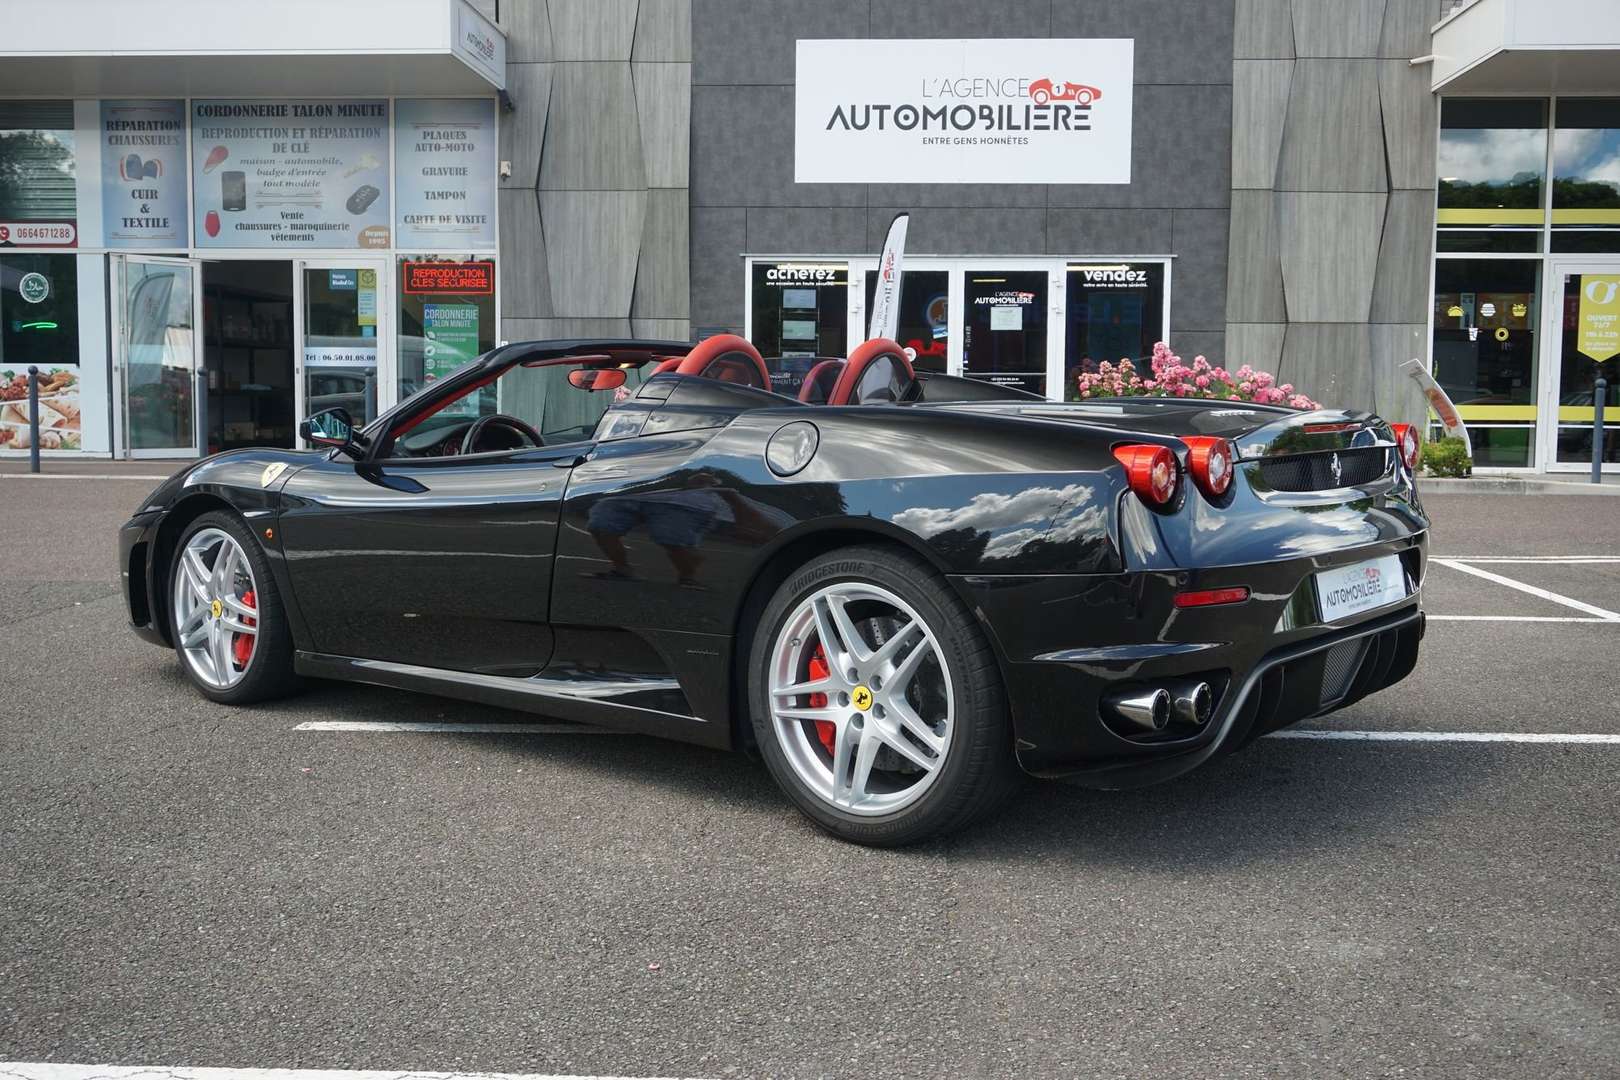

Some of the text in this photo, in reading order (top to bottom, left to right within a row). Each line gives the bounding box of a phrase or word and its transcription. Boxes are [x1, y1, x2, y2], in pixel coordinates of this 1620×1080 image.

[922, 78, 1029, 98] L'AGENCE
[197, 104, 385, 117] CORDONNERIE TALON MINUTE
[201, 125, 382, 139] REPRODUCTION ET RÉPARATION
[422, 130, 467, 141] PLAQUES
[107, 134, 180, 146] CHAUSSURES
[922, 135, 1029, 145] ENTRE GENS HONNÊTES
[272, 141, 311, 154] DE CLÉ
[414, 142, 475, 153] AUTO-MOTO
[256, 167, 286, 178] badge
[421, 167, 469, 177] GRAVURE
[263, 179, 283, 188] tout
[131, 189, 159, 200] CUIR
[423, 190, 467, 200] TAMPON
[139, 203, 151, 214] &
[280, 210, 304, 220] Vente
[403, 214, 487, 224] CARTE DE VISITE
[121, 217, 170, 228] TEXTILE
[235, 222, 282, 231] chaussures
[290, 222, 351, 233] maroquinerie
[17, 228, 71, 239] 0664671288
[270, 232, 315, 242] vêtements
[412, 268, 485, 278] REPRODUCTION
[1083, 264, 1147, 281] vendez
[424, 309, 479, 320] CORDONNERIE
[431, 320, 472, 328] TALON MINUTE
